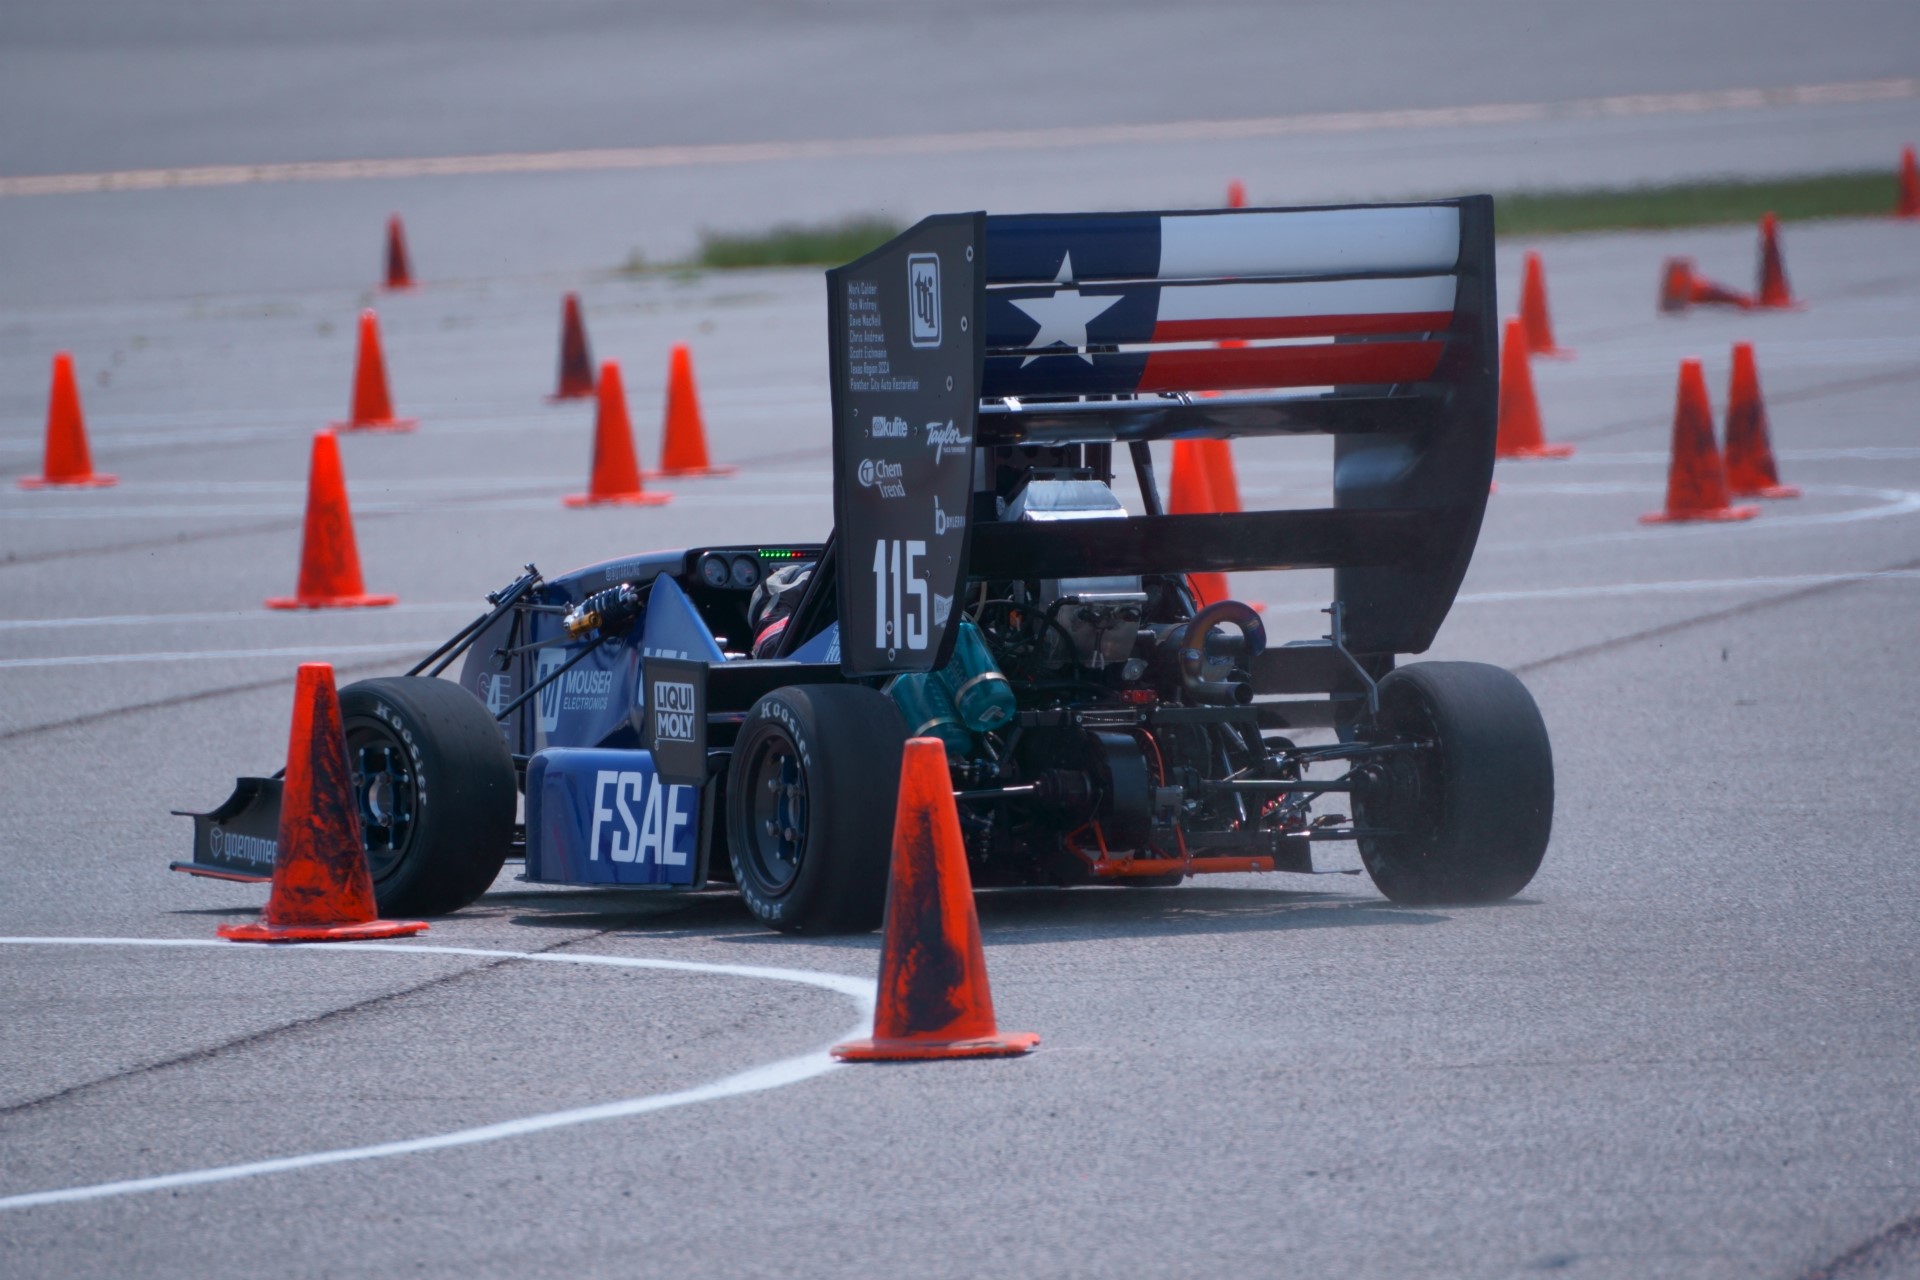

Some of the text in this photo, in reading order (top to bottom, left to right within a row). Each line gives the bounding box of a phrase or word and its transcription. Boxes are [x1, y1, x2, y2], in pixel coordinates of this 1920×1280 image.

[849, 329, 884, 343] Chris Andrews
[850, 346, 863, 359] Scott
[850, 361, 863, 374] Texas
[864, 361, 878, 376] Region
[850, 377, 870, 390] Panther
[871, 377, 880, 391] City
[881, 377, 892, 390] Auto
[883, 416, 908, 437] kulite
[925, 419, 973, 465] Taylor
[875, 459, 903, 478] Chem
[875, 480, 906, 498] Trend
[872, 539, 928, 650] 115
[565, 670, 613, 695] MOUSER
[563, 697, 608, 711] ELECTRONICS
[656, 685, 692, 711] LIQUI
[657, 712, 693, 738] MOLY
[590, 770, 693, 866] FSAE
[224, 832, 278, 867] goenginee
